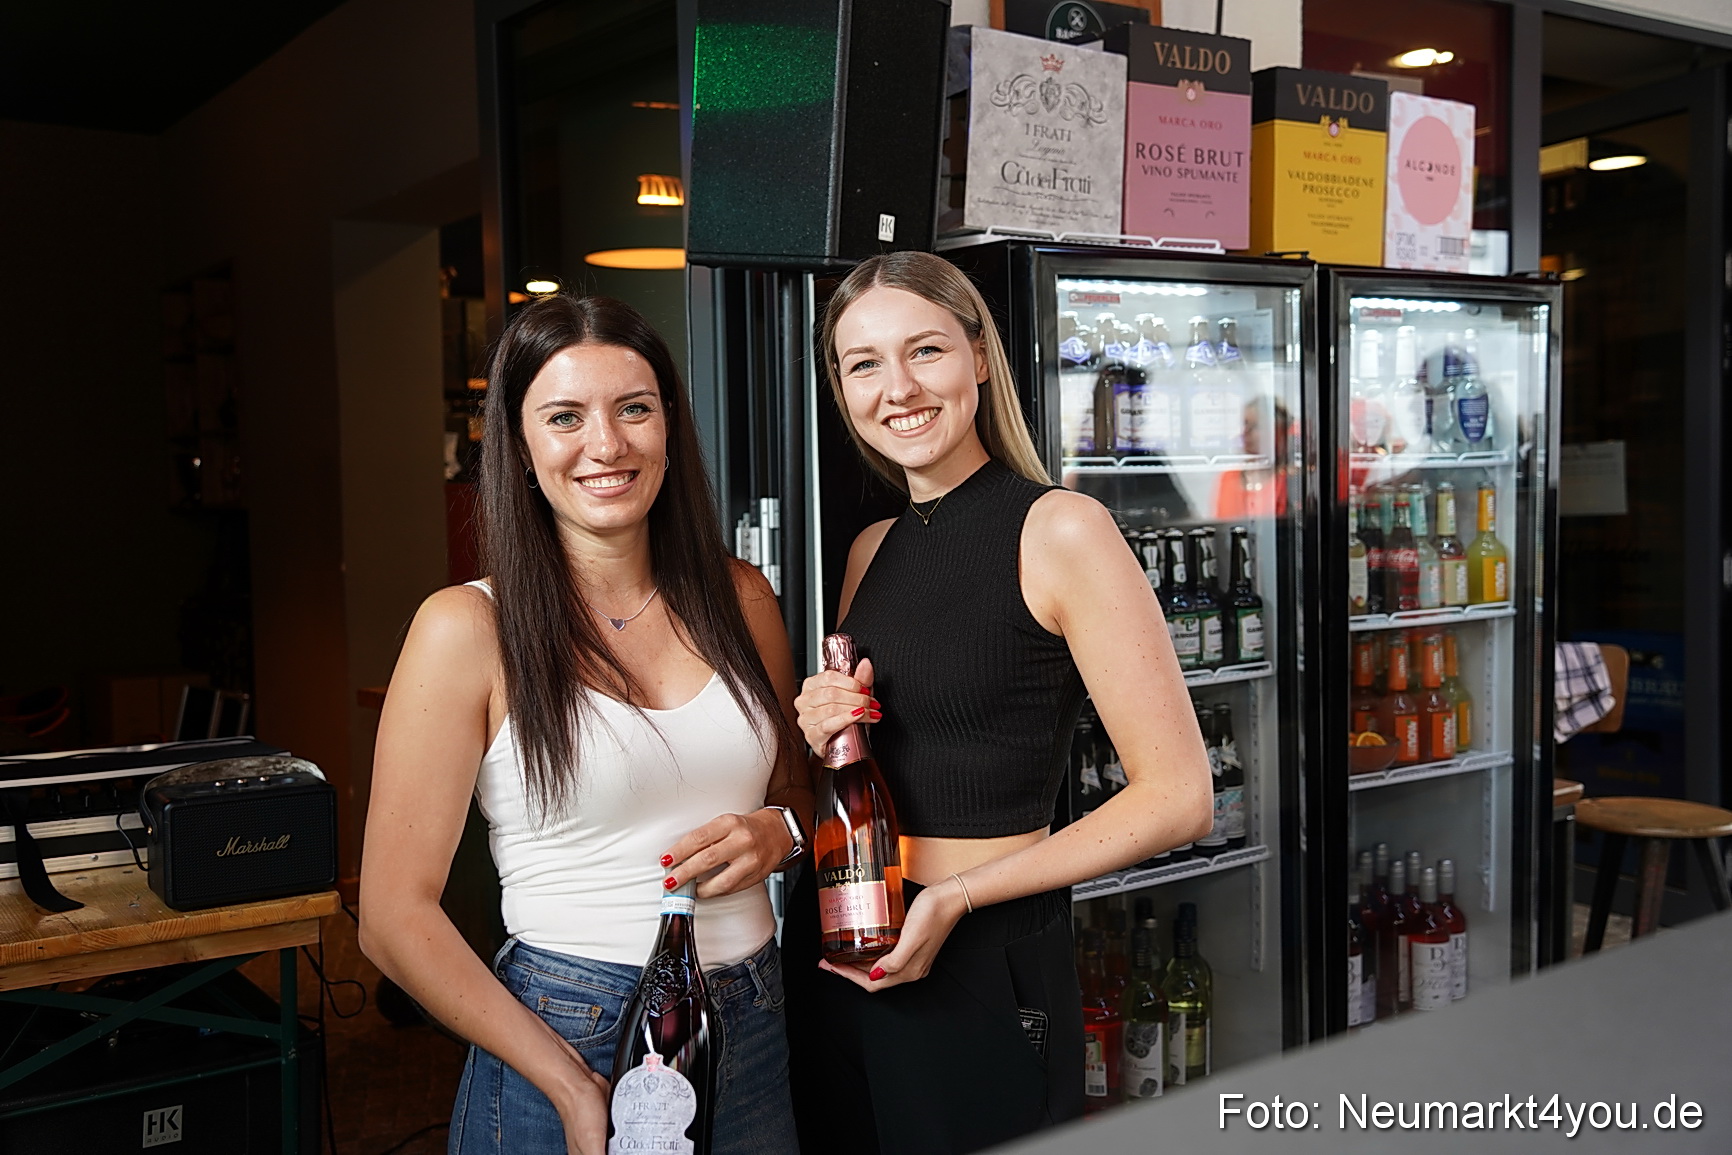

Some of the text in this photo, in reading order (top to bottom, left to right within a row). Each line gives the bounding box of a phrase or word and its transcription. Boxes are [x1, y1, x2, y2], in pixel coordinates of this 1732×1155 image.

[1153, 41, 1231, 75] VALDO
[1295, 83, 1374, 114] VALDO
[1158, 115, 1223, 131] MARCA ORO
[1033, 124, 1072, 142] FRATI
[1135, 142, 1245, 168] ROSÉ BRUT
[1303, 150, 1362, 165] MARCA ORO
[1141, 164, 1239, 184] VINO SPUMANTE
[1287, 169, 1375, 189] VALDOBBIADENE
[1302, 183, 1361, 199] PROSECCO
[216, 833, 291, 857] Marshall
[824, 868, 865, 882] VALDO
[825, 902, 870, 915] ROSÉ BRUT
[638, 1101, 670, 1111] FRATI
[147, 1108, 179, 1136] HK
[147, 1133, 178, 1143] AUDIO
